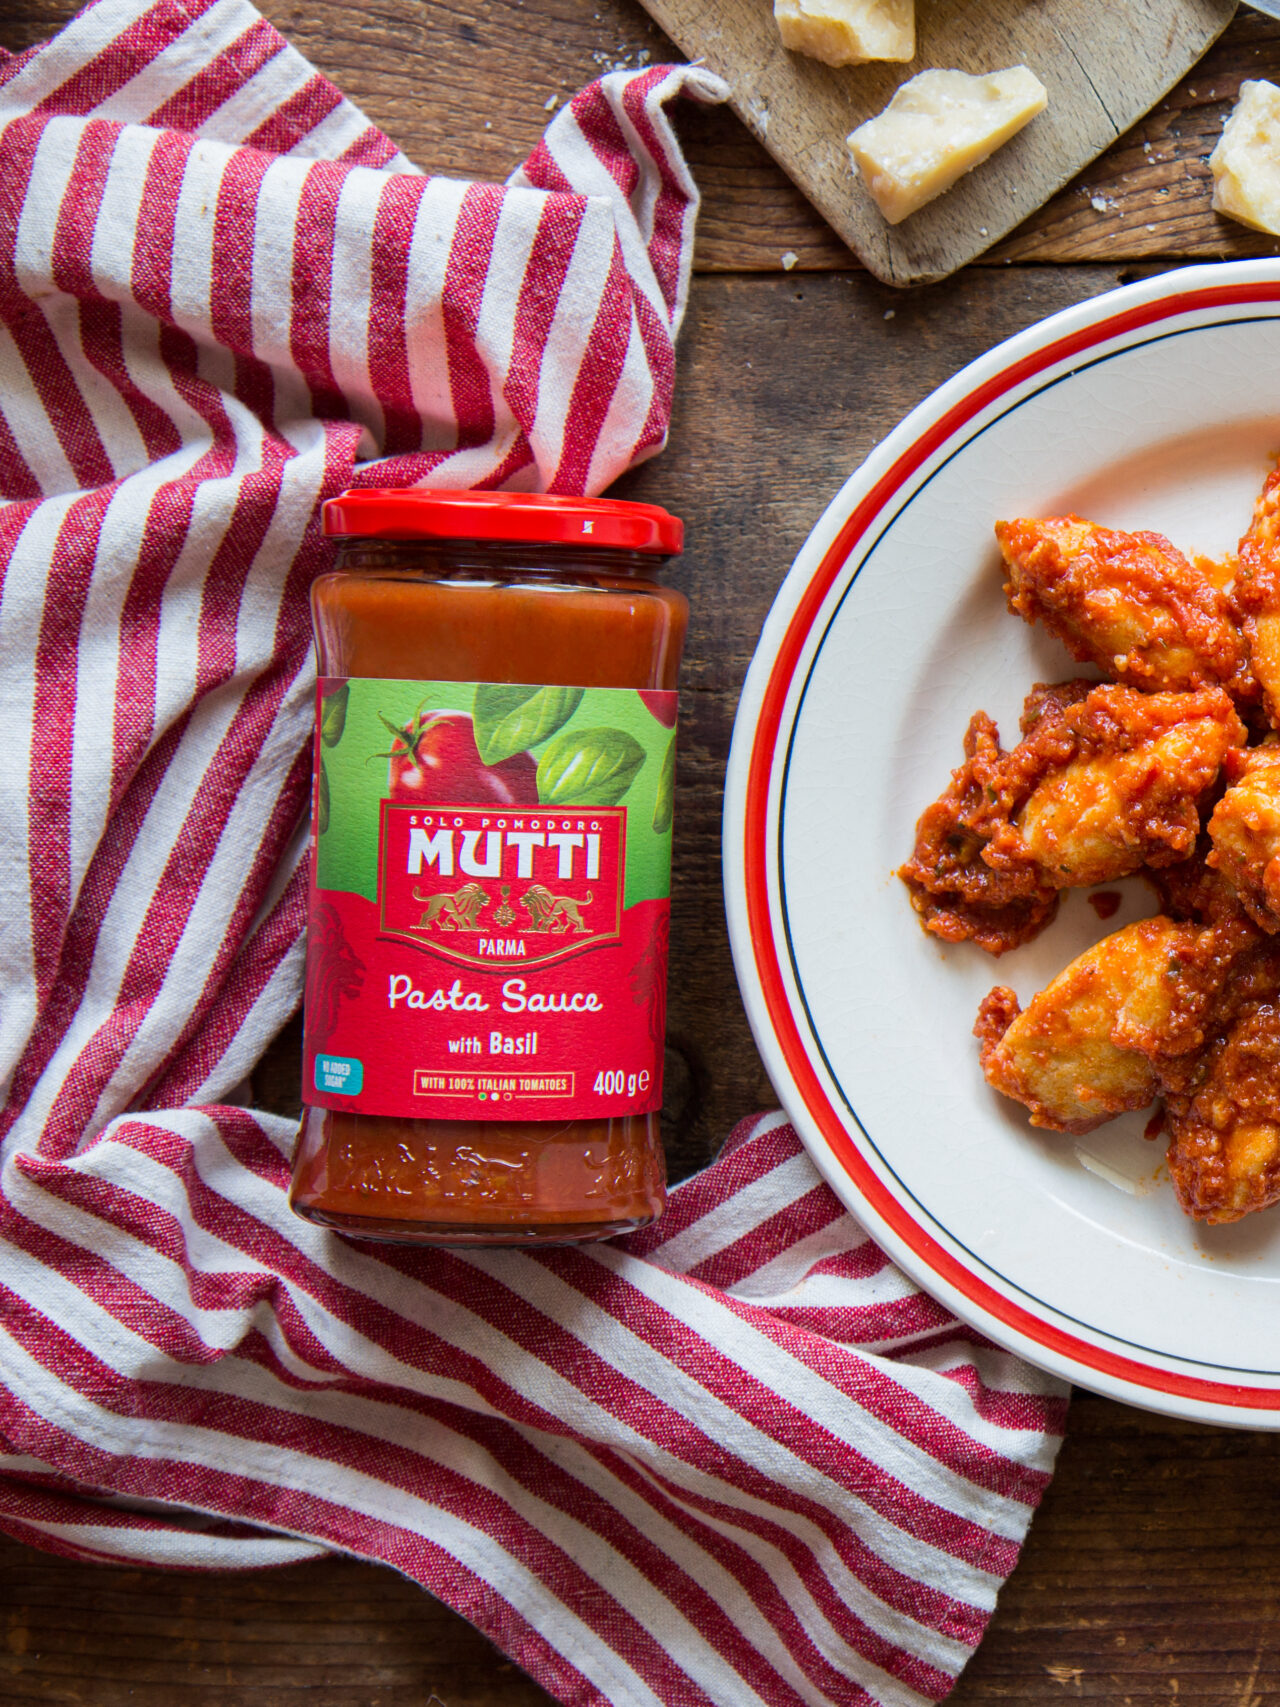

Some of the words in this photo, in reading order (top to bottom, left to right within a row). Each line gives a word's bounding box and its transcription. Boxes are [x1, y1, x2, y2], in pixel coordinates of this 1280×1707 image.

[410, 815, 464, 828] SOLO
[407, 828, 601, 880] MUTTI
[478, 938, 526, 956] PARMA
[388, 974, 489, 1011] Pasta
[501, 978, 603, 1013] Sauce
[448, 1036, 482, 1054] with
[489, 1031, 538, 1055] Basil
[420, 1076, 445, 1090] WITH
[448, 1077, 475, 1090] 100%
[477, 1078, 516, 1091] ITALIAN
[519, 1078, 567, 1091] TOMATOES
[593, 1070, 625, 1096] 400
